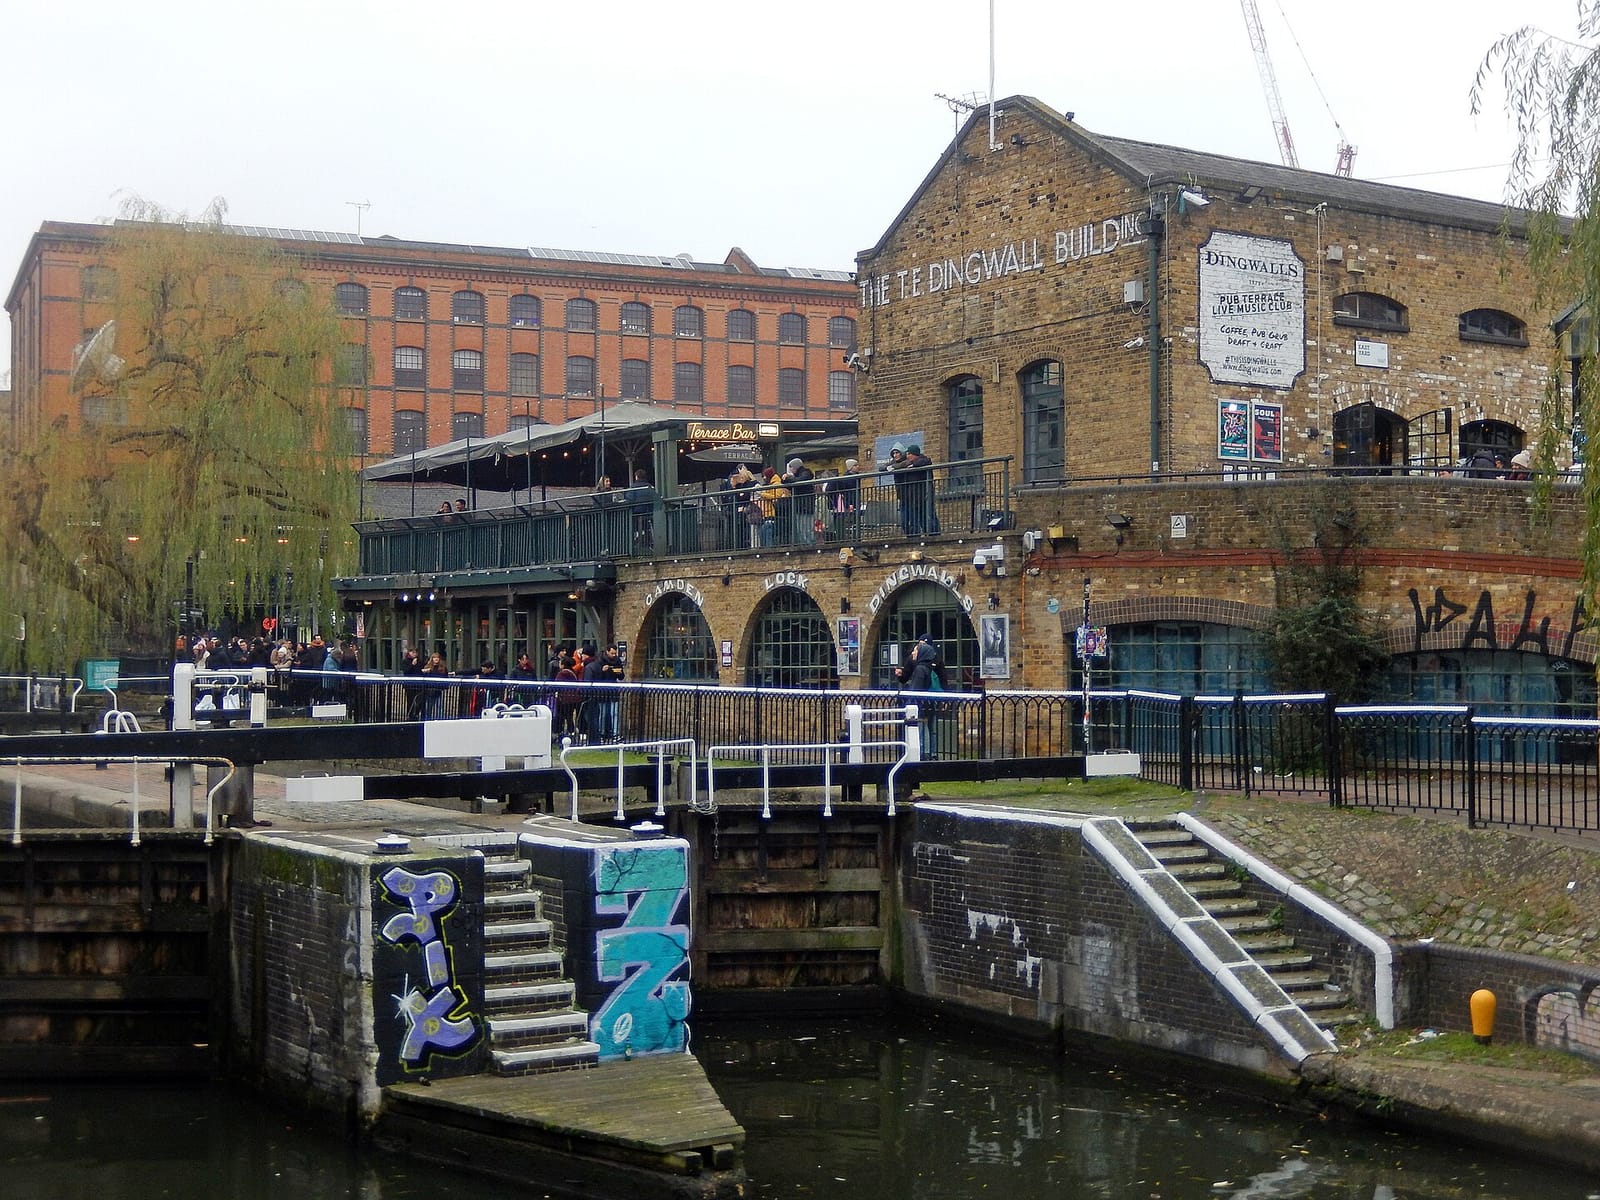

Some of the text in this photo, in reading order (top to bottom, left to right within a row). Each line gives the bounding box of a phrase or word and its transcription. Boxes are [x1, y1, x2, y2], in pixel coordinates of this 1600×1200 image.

[1205, 250, 1299, 278] DINGWALLS
[859, 275, 890, 308] THE
[929, 238, 1044, 293] DINGWALL
[1219, 292, 1285, 305] PUB TERRACE
[1212, 301, 1292, 315] LIVE MUSIC CLUB
[1251, 327, 1266, 338] PUB
[1268, 331, 1289, 341] GRUB
[1227, 337, 1251, 347] DRAFT
[1260, 341, 1283, 351] CRAFT
[1254, 408, 1275, 417] SOUL
[688, 422, 730, 440] Terrace
[732, 423, 756, 440] Bar
[765, 571, 809, 591] LOCK
[645, 579, 705, 607] CAMDEN
